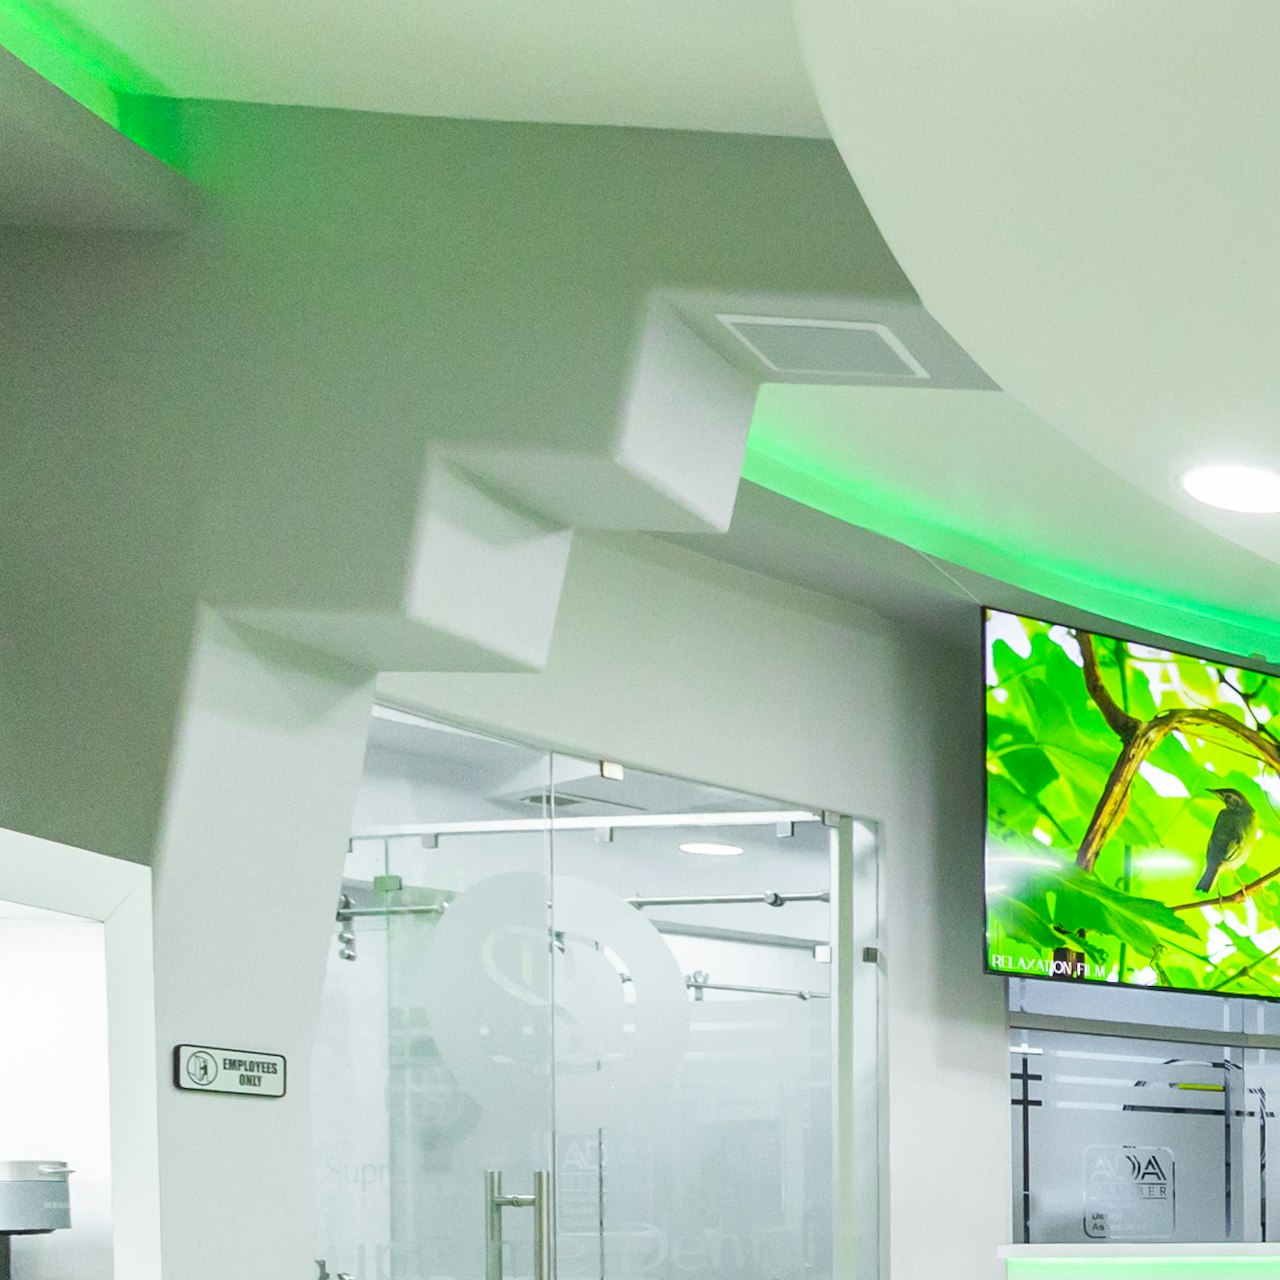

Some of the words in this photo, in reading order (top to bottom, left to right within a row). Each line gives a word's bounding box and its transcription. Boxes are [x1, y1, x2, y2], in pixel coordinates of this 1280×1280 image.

[991, 954, 1072, 977] RELAXATION
[1076, 962, 1106, 978] FILM
[222, 1057, 279, 1075] EMPLOYEES
[238, 1074, 263, 1088] ONLY
